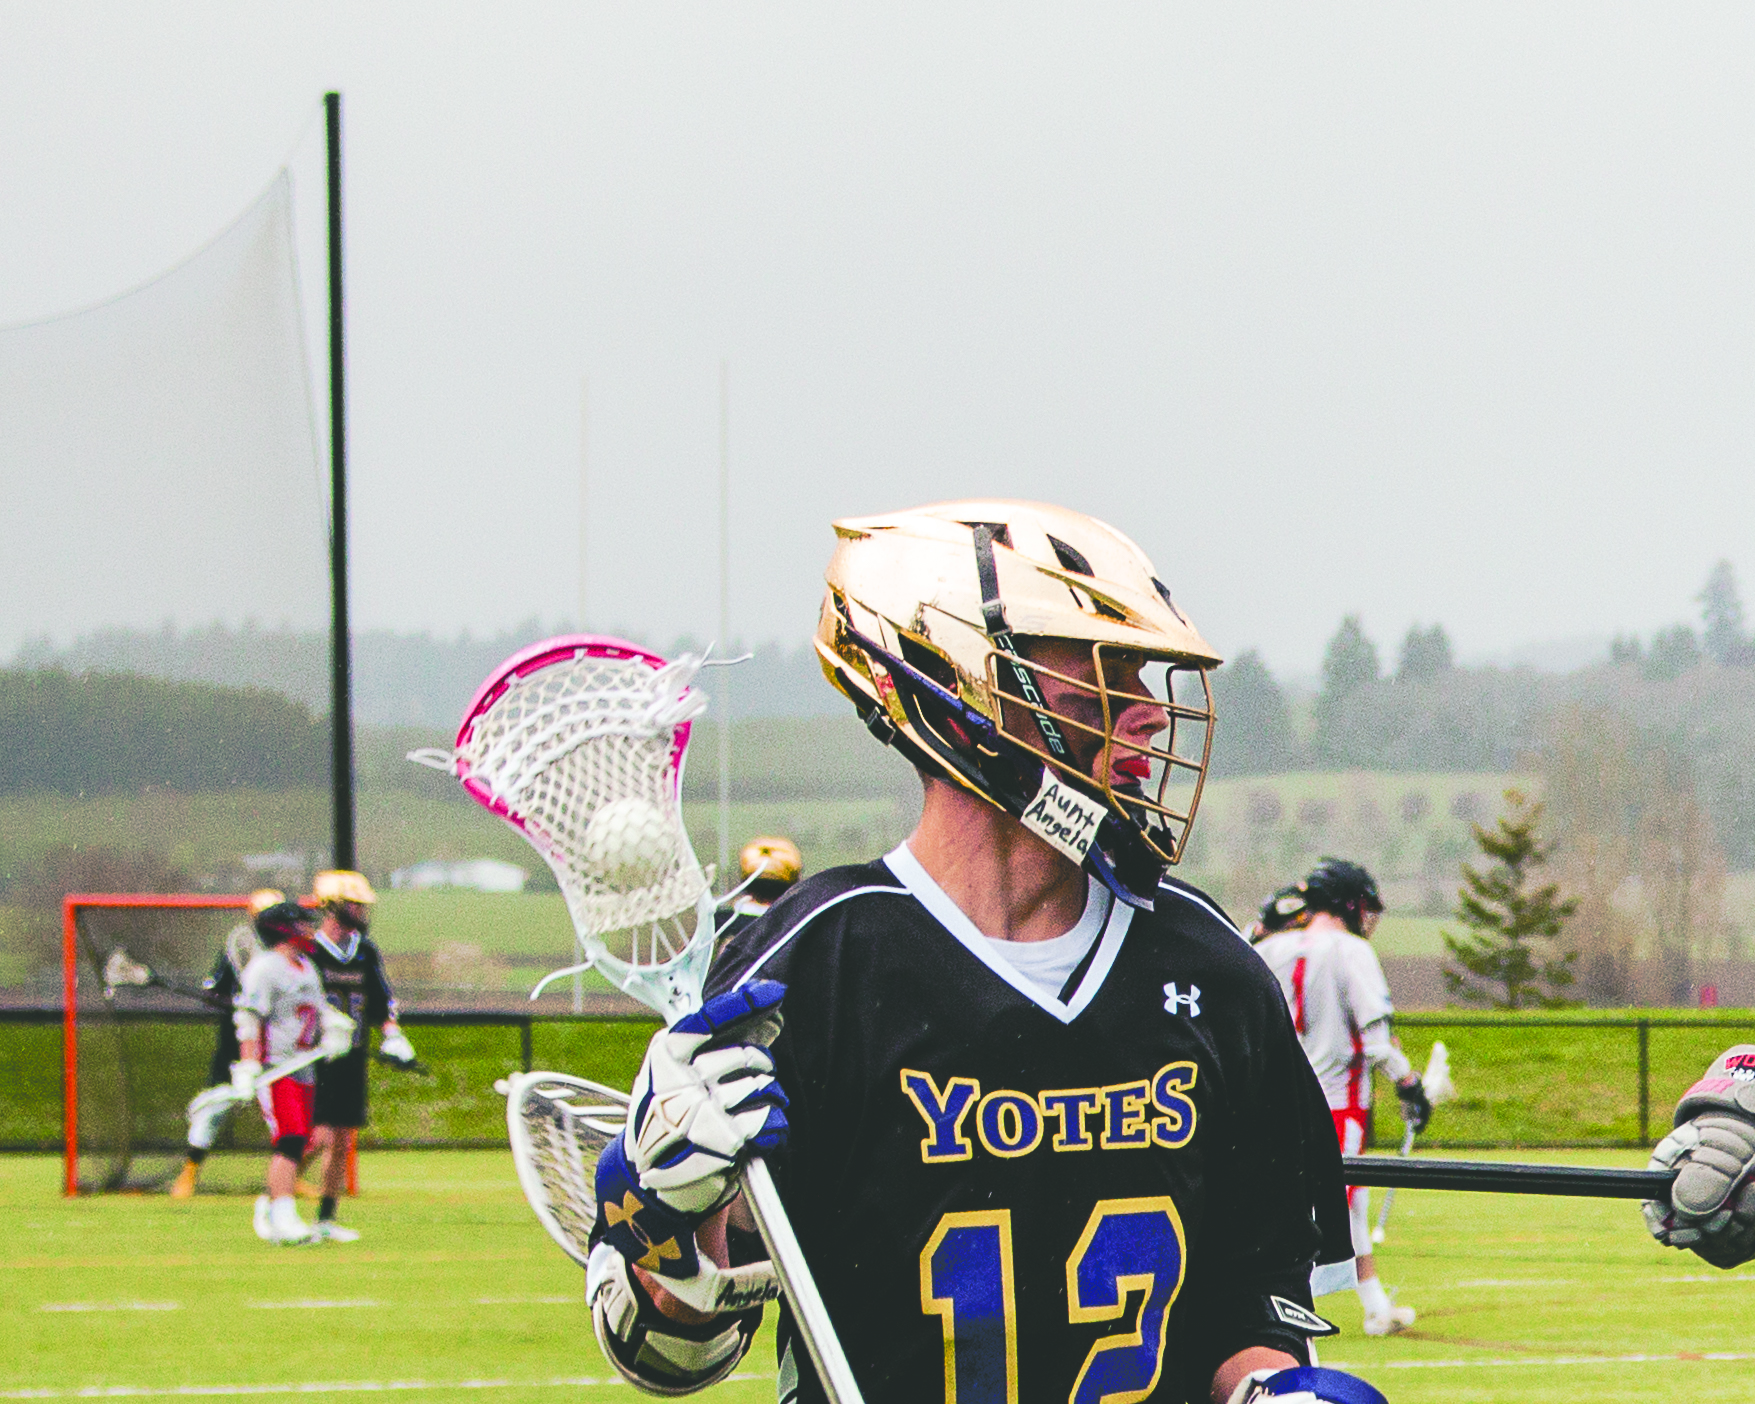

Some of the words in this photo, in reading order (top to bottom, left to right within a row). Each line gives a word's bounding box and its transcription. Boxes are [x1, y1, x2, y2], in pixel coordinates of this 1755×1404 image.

[1024, 798, 1089, 856] Angela
[1043, 783, 1095, 831] Aunt
[900, 1060, 1199, 1164] YOTES
